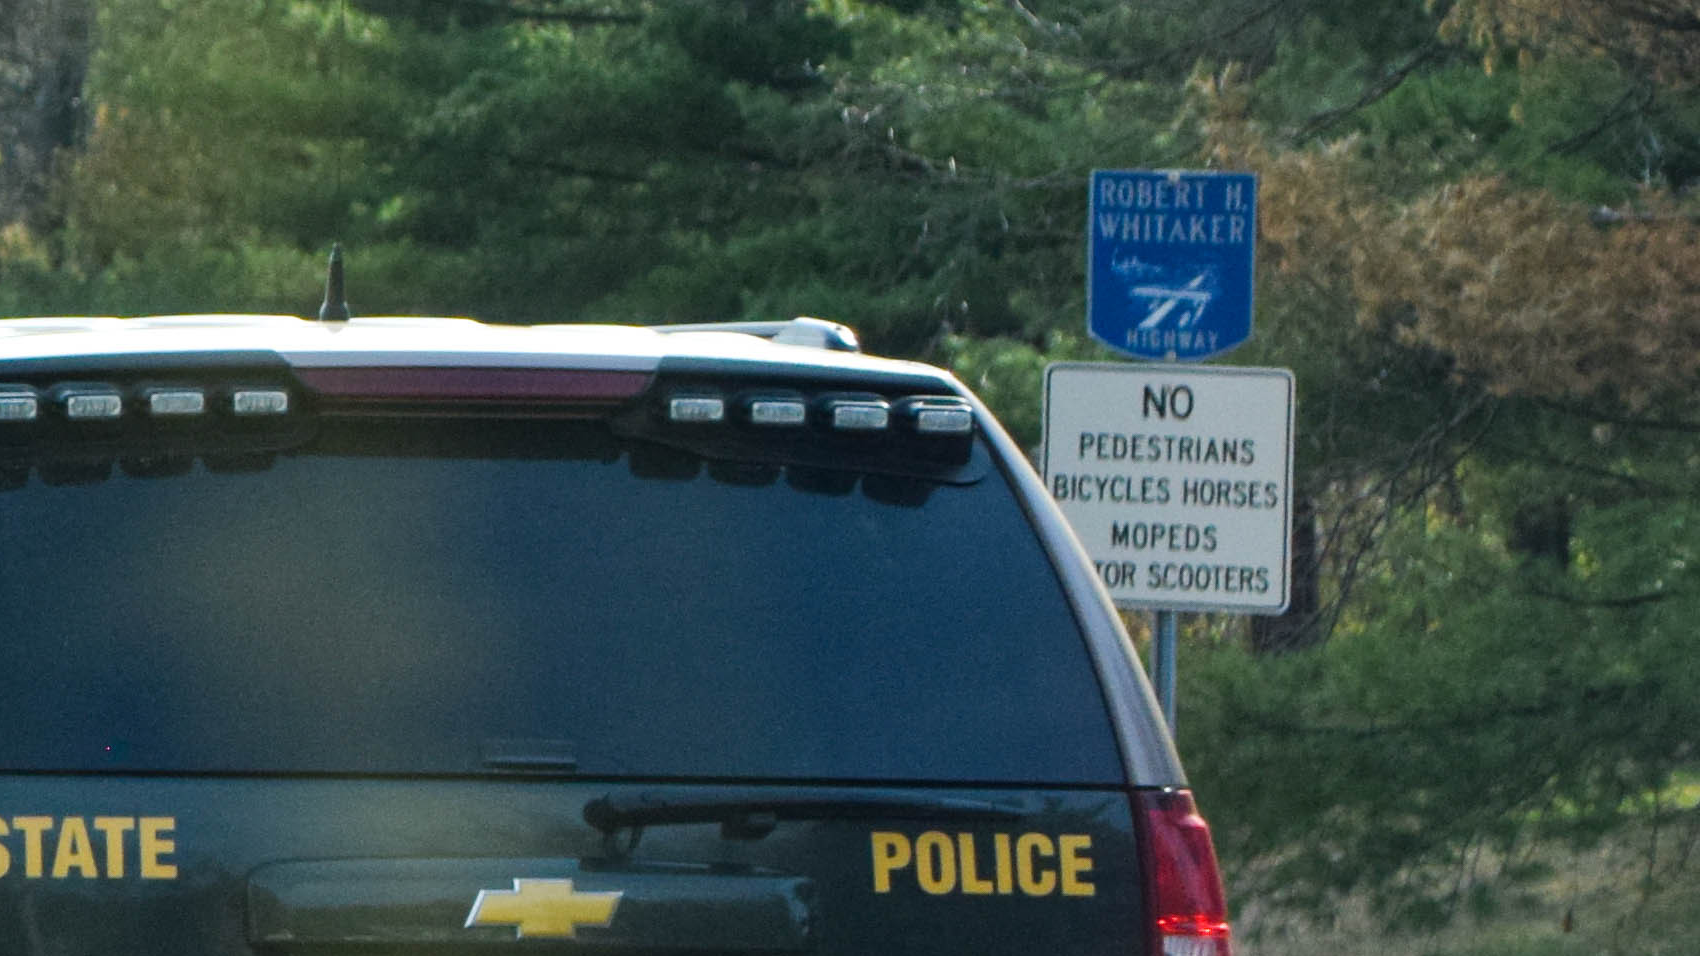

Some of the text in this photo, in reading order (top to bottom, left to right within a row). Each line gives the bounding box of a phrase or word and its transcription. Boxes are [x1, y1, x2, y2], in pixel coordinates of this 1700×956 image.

[1101, 178, 1208, 209] ROBERT
[1099, 211, 1245, 243] WHITAKER
[1127, 328, 1218, 349] HIGHWAY
[1142, 384, 1194, 419] NO
[1079, 432, 1255, 465] PEDESTRIANS
[1053, 474, 1278, 509] BICYCLES HORSES
[1111, 521, 1217, 552] MOPEDS
[1147, 561, 1269, 594] SCOOTERS
[871, 831, 1096, 896] POLICE
